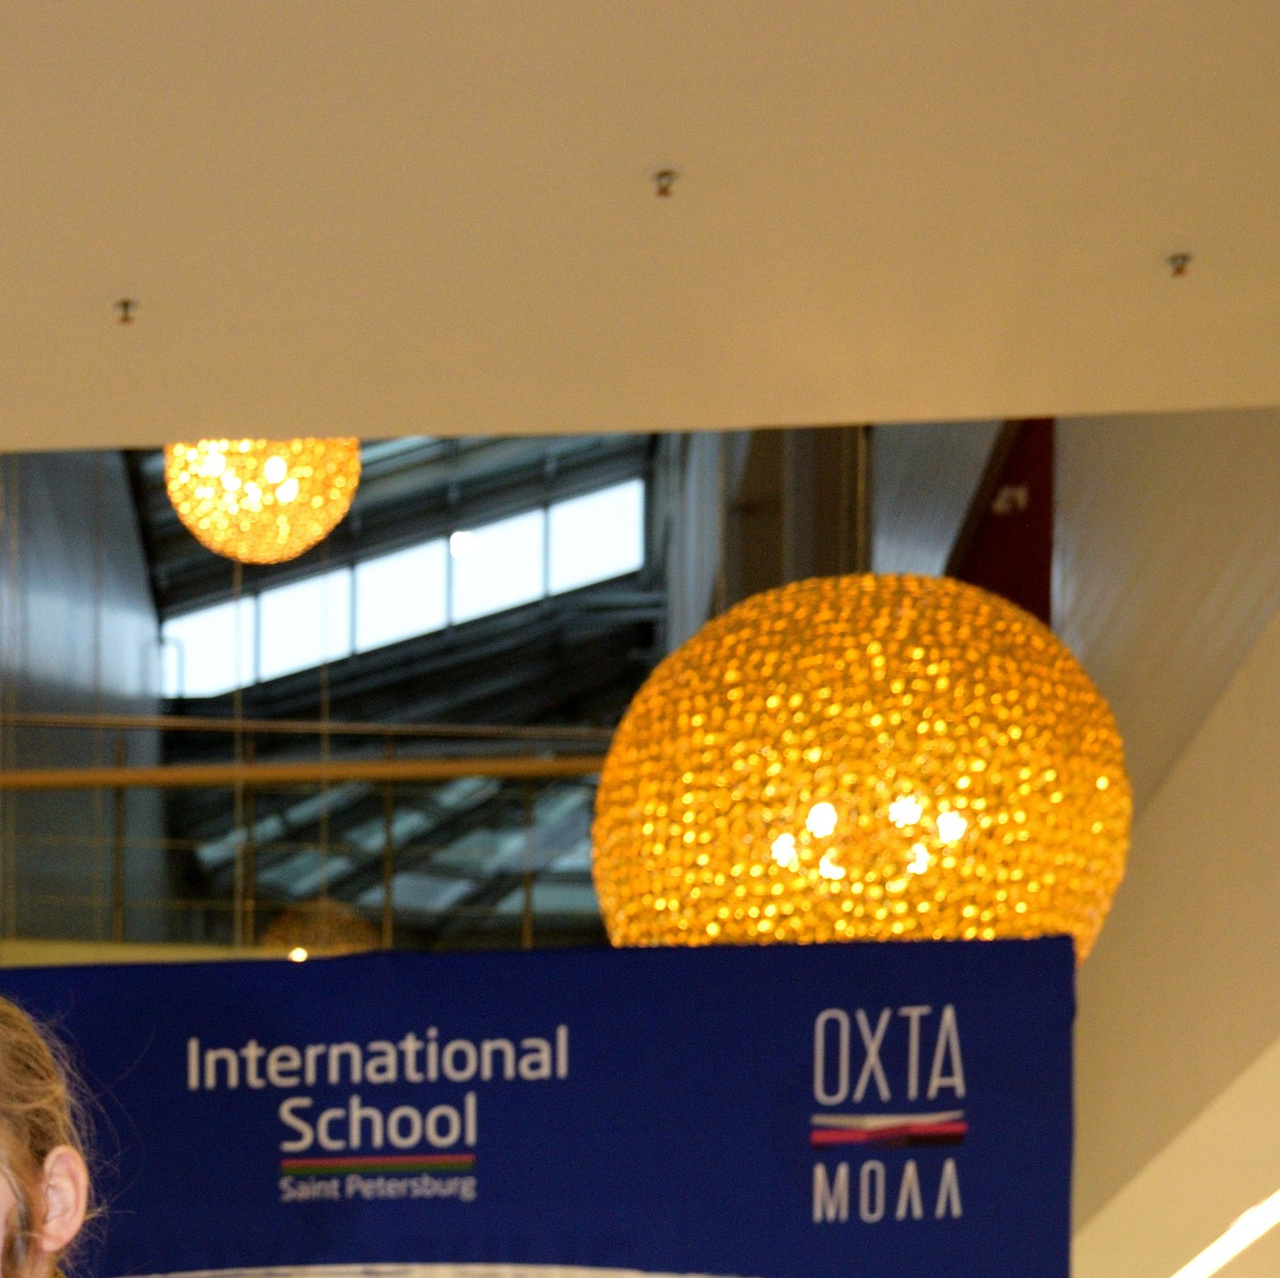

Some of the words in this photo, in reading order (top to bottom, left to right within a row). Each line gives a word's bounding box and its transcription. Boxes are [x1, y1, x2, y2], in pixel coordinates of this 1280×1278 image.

[187, 1024, 569, 1090] International
[813, 1004, 966, 1106] ОХТА
[278, 1093, 478, 1152] School
[278, 1174, 340, 1201] Saint
[345, 1171, 477, 1202] Petersburg
